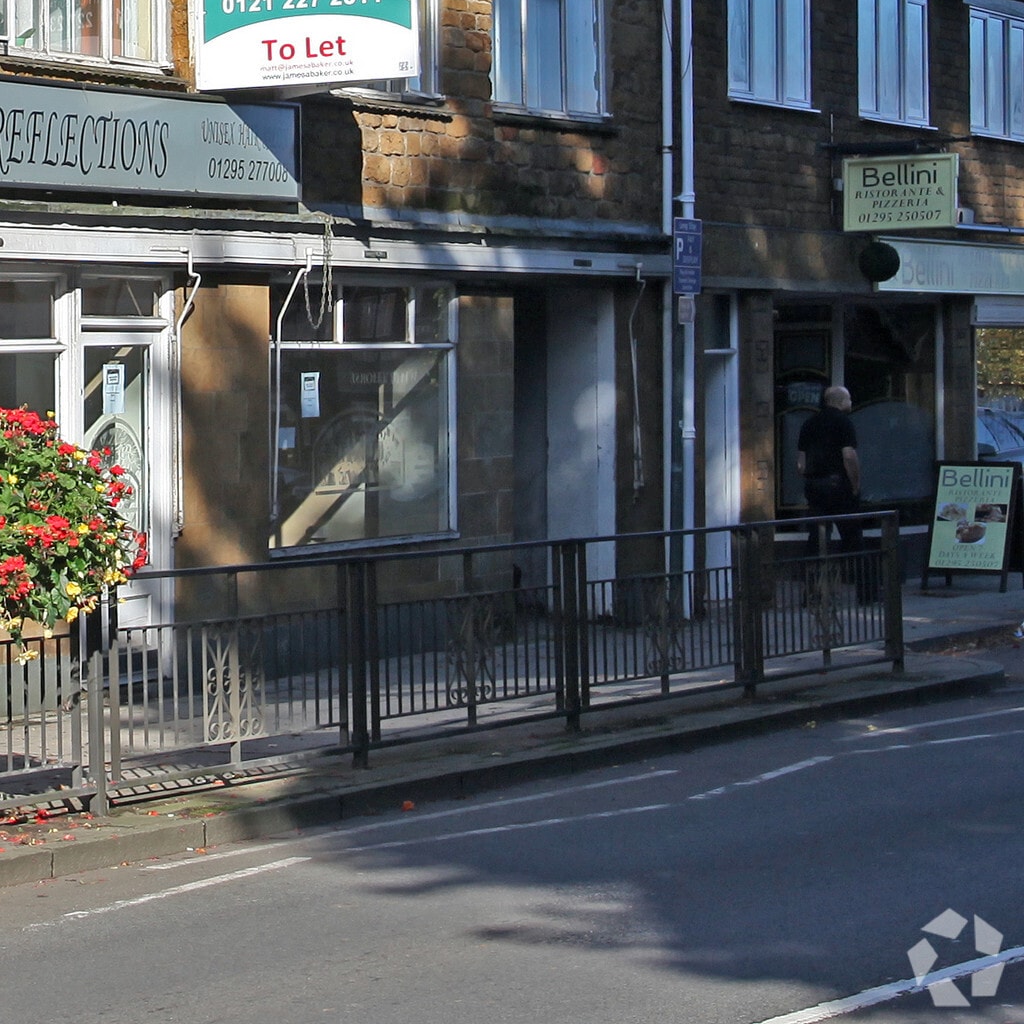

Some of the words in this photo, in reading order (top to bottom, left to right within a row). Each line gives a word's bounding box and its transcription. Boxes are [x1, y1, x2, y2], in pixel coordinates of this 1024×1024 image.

[261, 39, 296, 62] To
[305, 36, 347, 59] Let
[262, 68, 354, 81] www.jamesabaker.co.uk
[201, 118, 236, 146] UNISEX
[208, 157, 245, 180] 01295
[862, 162, 937, 188] Bellini
[855, 187, 933, 199] RISTORANTE
[936, 186, 945, 196] &
[872, 198, 928, 209] PIZZERIA
[858, 212, 893, 224] 01295
[896, 210, 942, 222] 250507
[676, 237, 684, 260] P
[901, 247, 955, 286] Bellini
[942, 468, 1010, 488] Bellini
